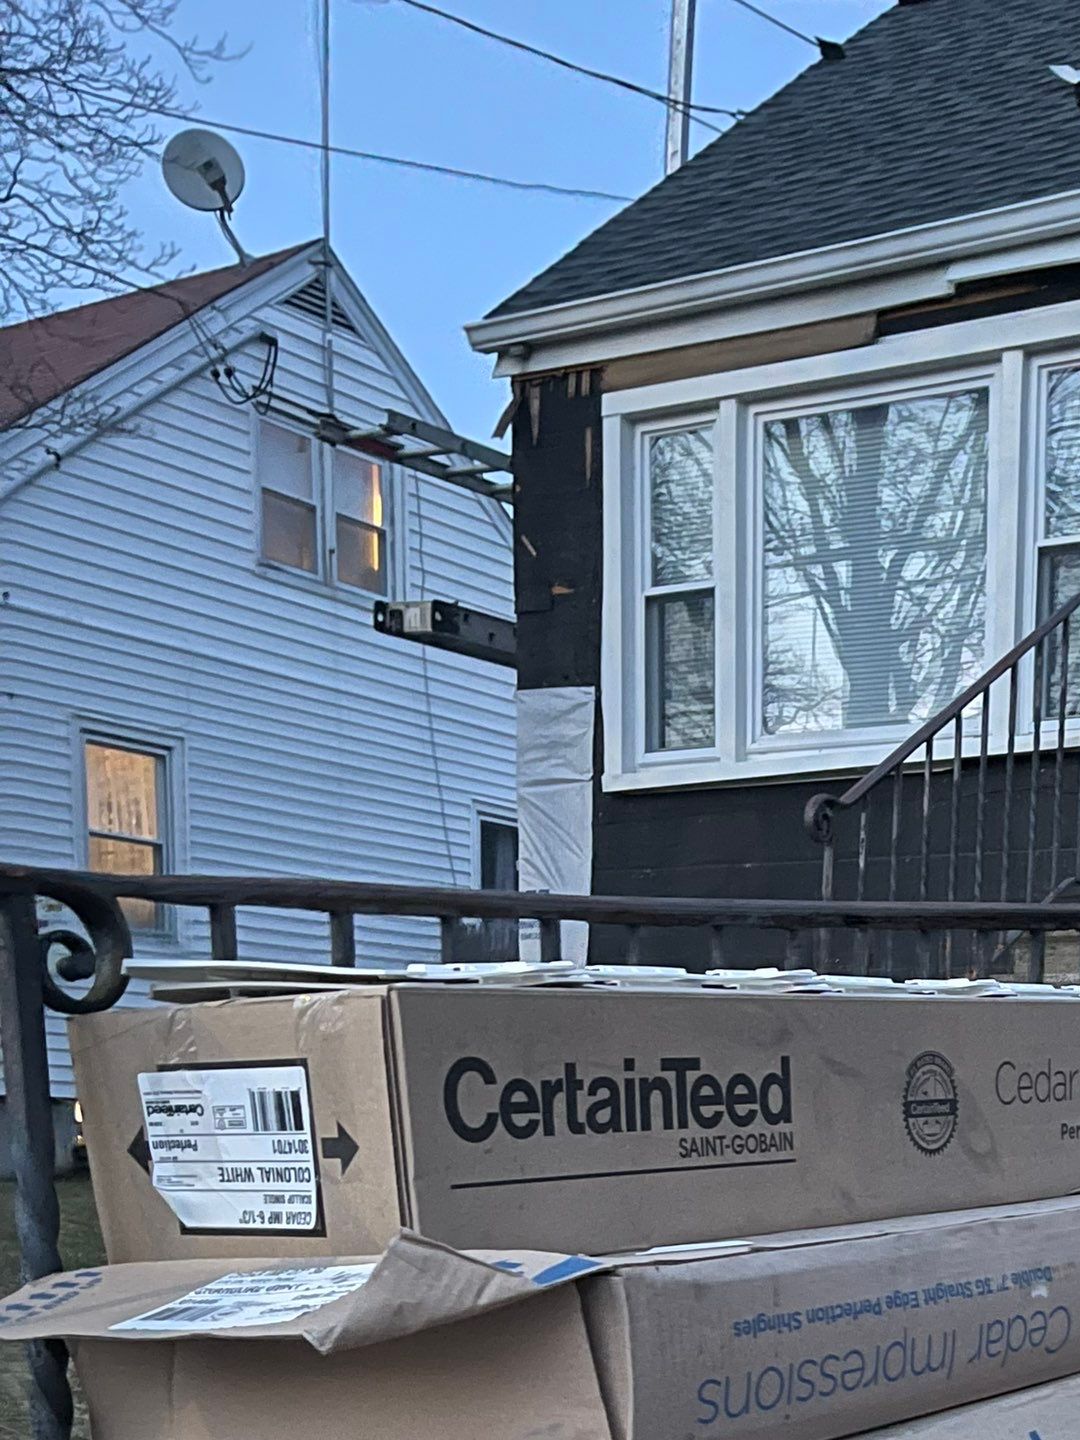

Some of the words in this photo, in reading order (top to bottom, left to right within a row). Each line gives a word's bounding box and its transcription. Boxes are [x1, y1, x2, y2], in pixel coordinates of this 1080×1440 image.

[994, 1058, 1079, 1106] Cedar
[443, 1056, 793, 1144] CertainTeed
[678, 1131, 795, 1159] SAINT-GOBAIN
[217, 1167, 256, 1184] WHITE
[257, 1167, 312, 1184] COLONIAL
[805, 1297, 883, 1326] Perfection
[885, 1289, 920, 1311] Edge
[733, 1311, 803, 1339] Shingles
[967, 1305, 1072, 1368] Cedar
[697, 1326, 957, 1425] Impressions
